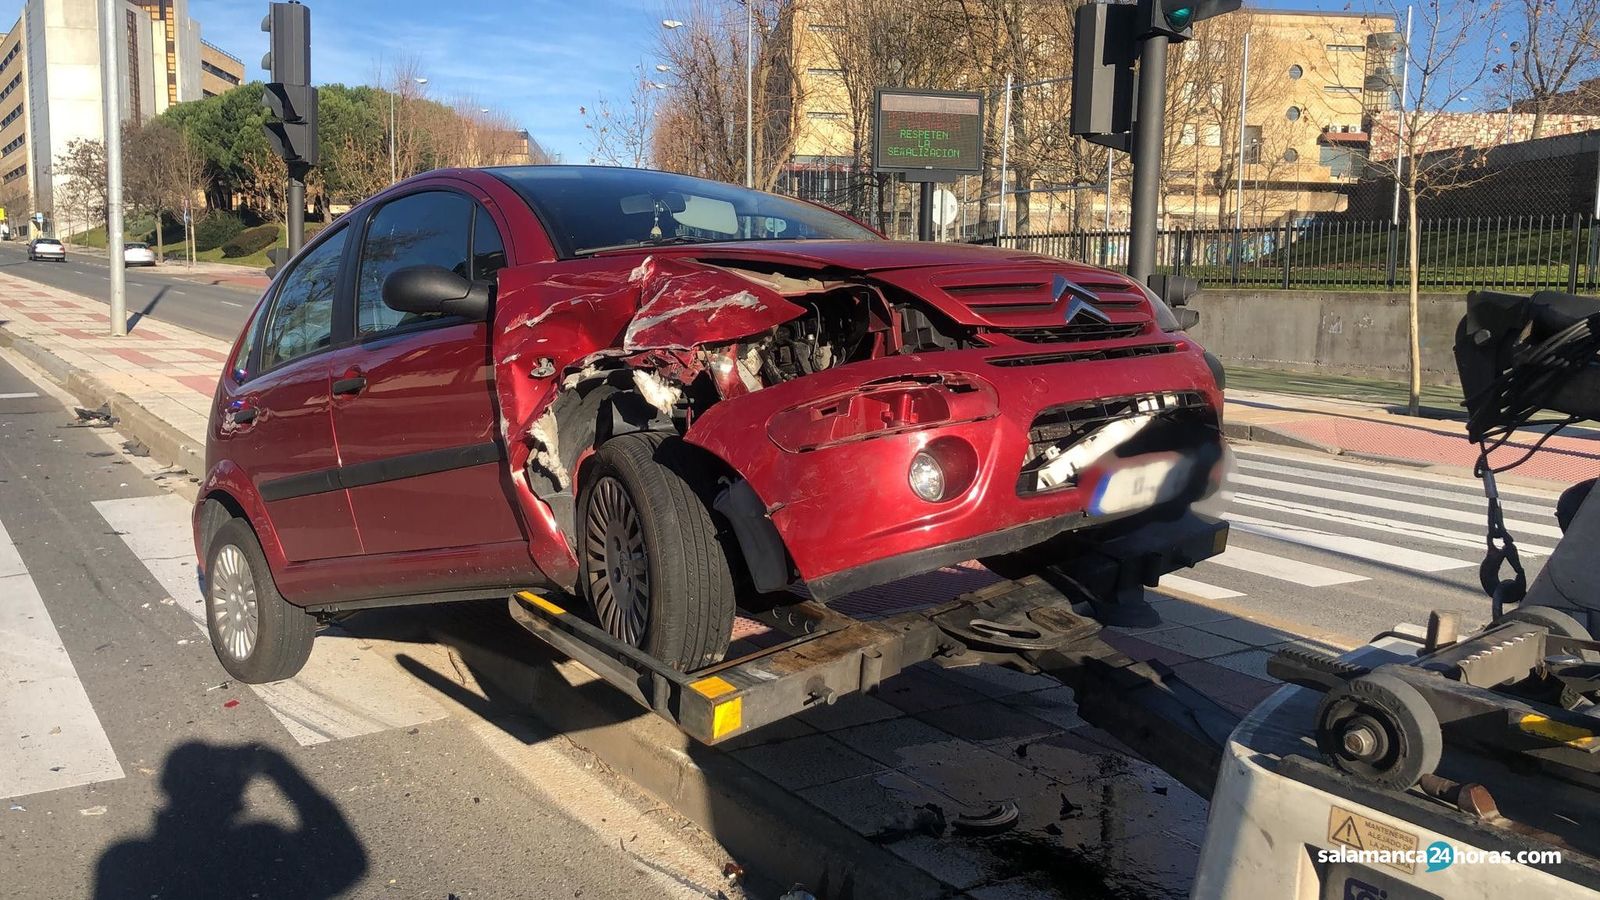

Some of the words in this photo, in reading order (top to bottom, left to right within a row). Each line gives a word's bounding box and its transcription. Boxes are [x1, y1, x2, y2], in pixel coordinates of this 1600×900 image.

[900, 129, 949, 140] RESPETEN
[917, 139, 931, 148] LA
[1365, 821, 1414, 845] MANTENERSE
[1368, 831, 1402, 848] ALEJADO
